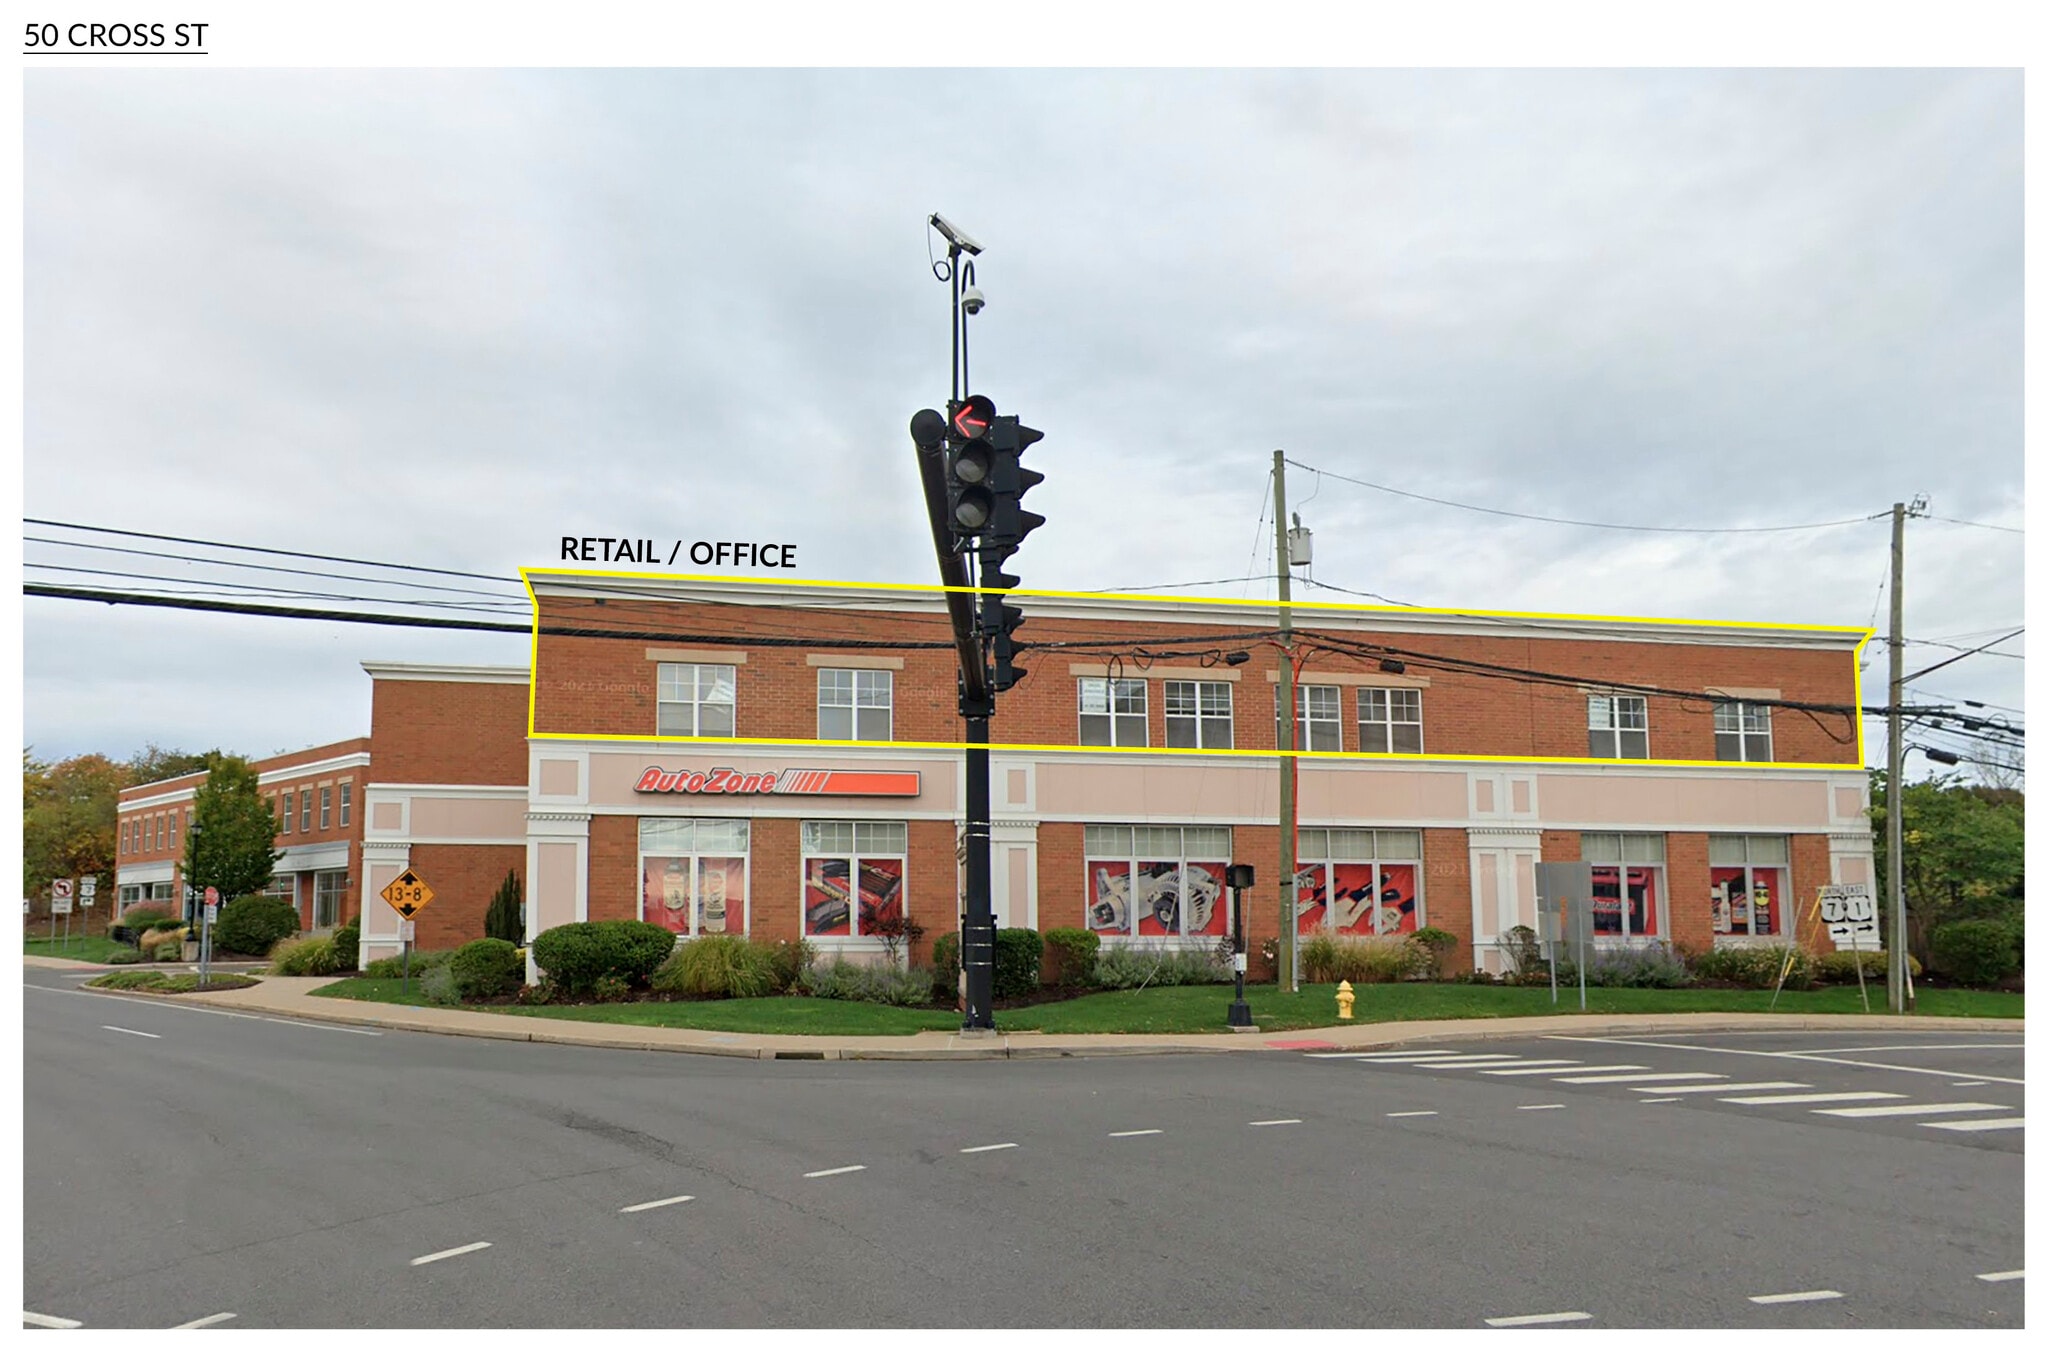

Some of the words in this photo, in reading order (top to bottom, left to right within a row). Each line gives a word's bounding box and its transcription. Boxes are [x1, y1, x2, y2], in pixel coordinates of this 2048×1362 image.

[635, 767, 778, 794] AutoZone
[1845, 885, 1864, 895] EAST
[1827, 903, 1836, 917] 7
[1855, 902, 1861, 916] 1
